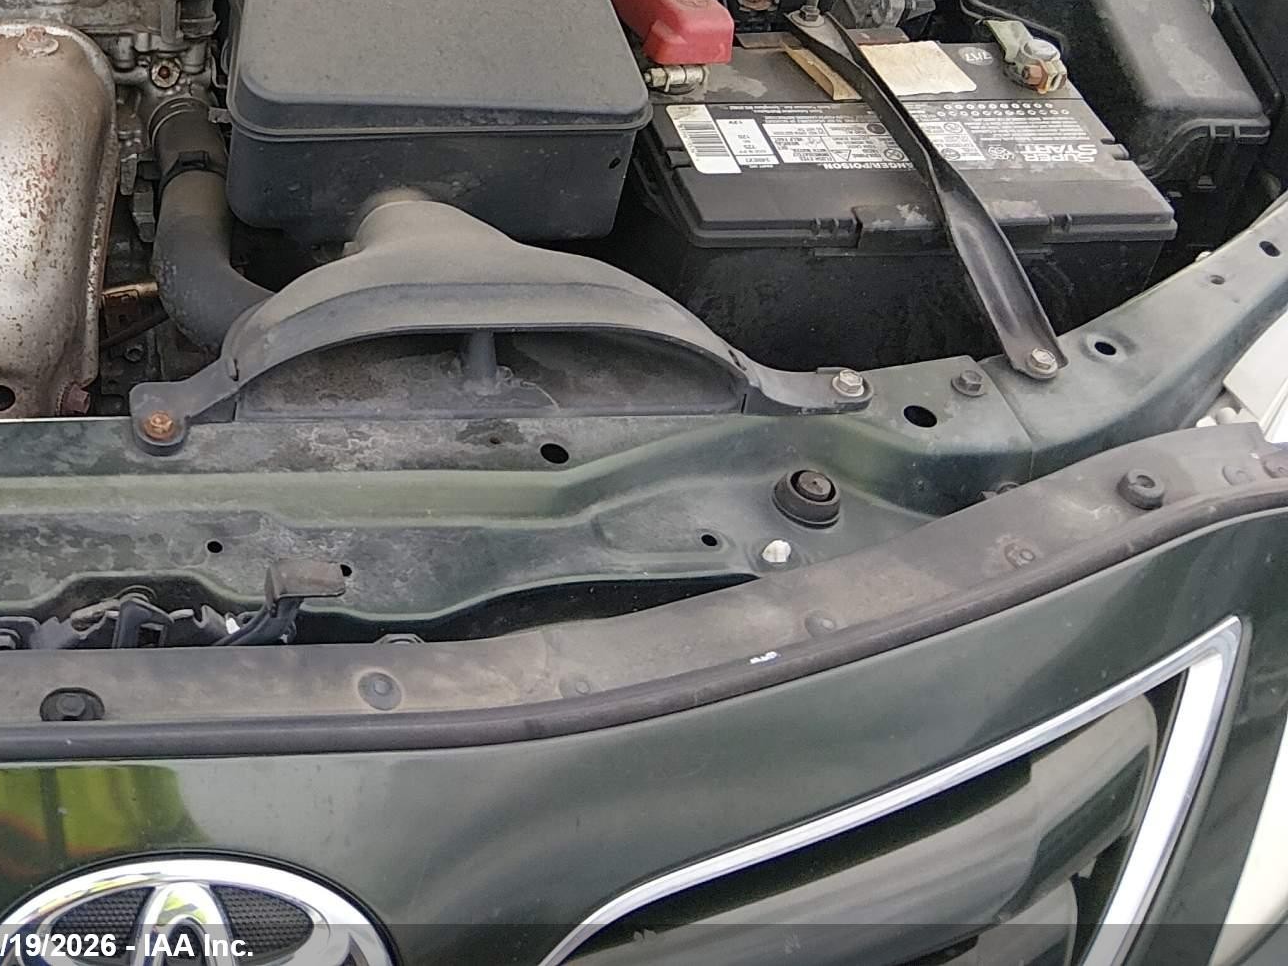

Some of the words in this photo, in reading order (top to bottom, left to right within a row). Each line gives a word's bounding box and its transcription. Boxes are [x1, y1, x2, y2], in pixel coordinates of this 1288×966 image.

[1020, 144, 1097, 154] START
[1023, 153, 1096, 163] SUPER
[823, 162, 914, 170] ANGER/POISON
